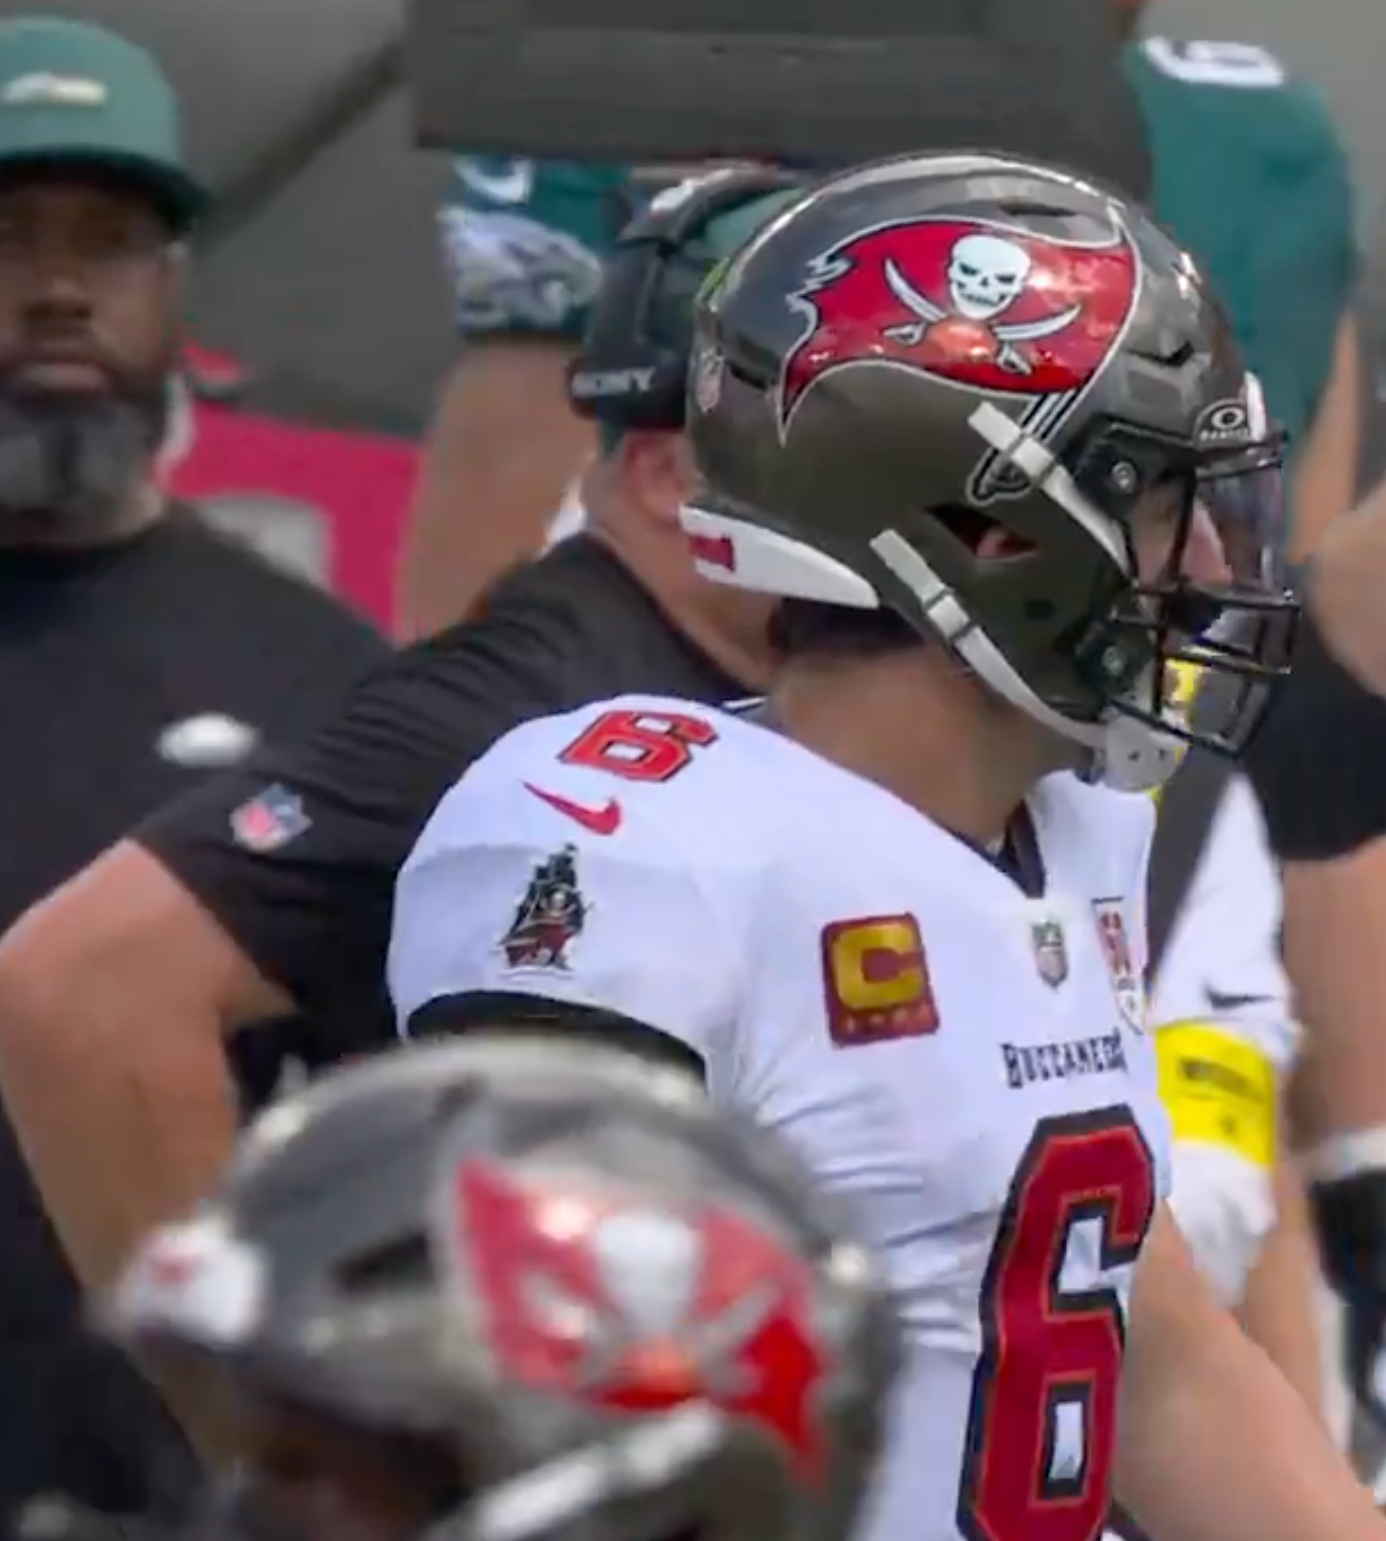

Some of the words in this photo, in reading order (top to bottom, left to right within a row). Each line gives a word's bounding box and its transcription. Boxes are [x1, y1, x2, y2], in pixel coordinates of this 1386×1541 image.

[556, 709, 719, 783] 6
[832, 922, 922, 1010] C
[956, 1102, 1156, 1541] 6
